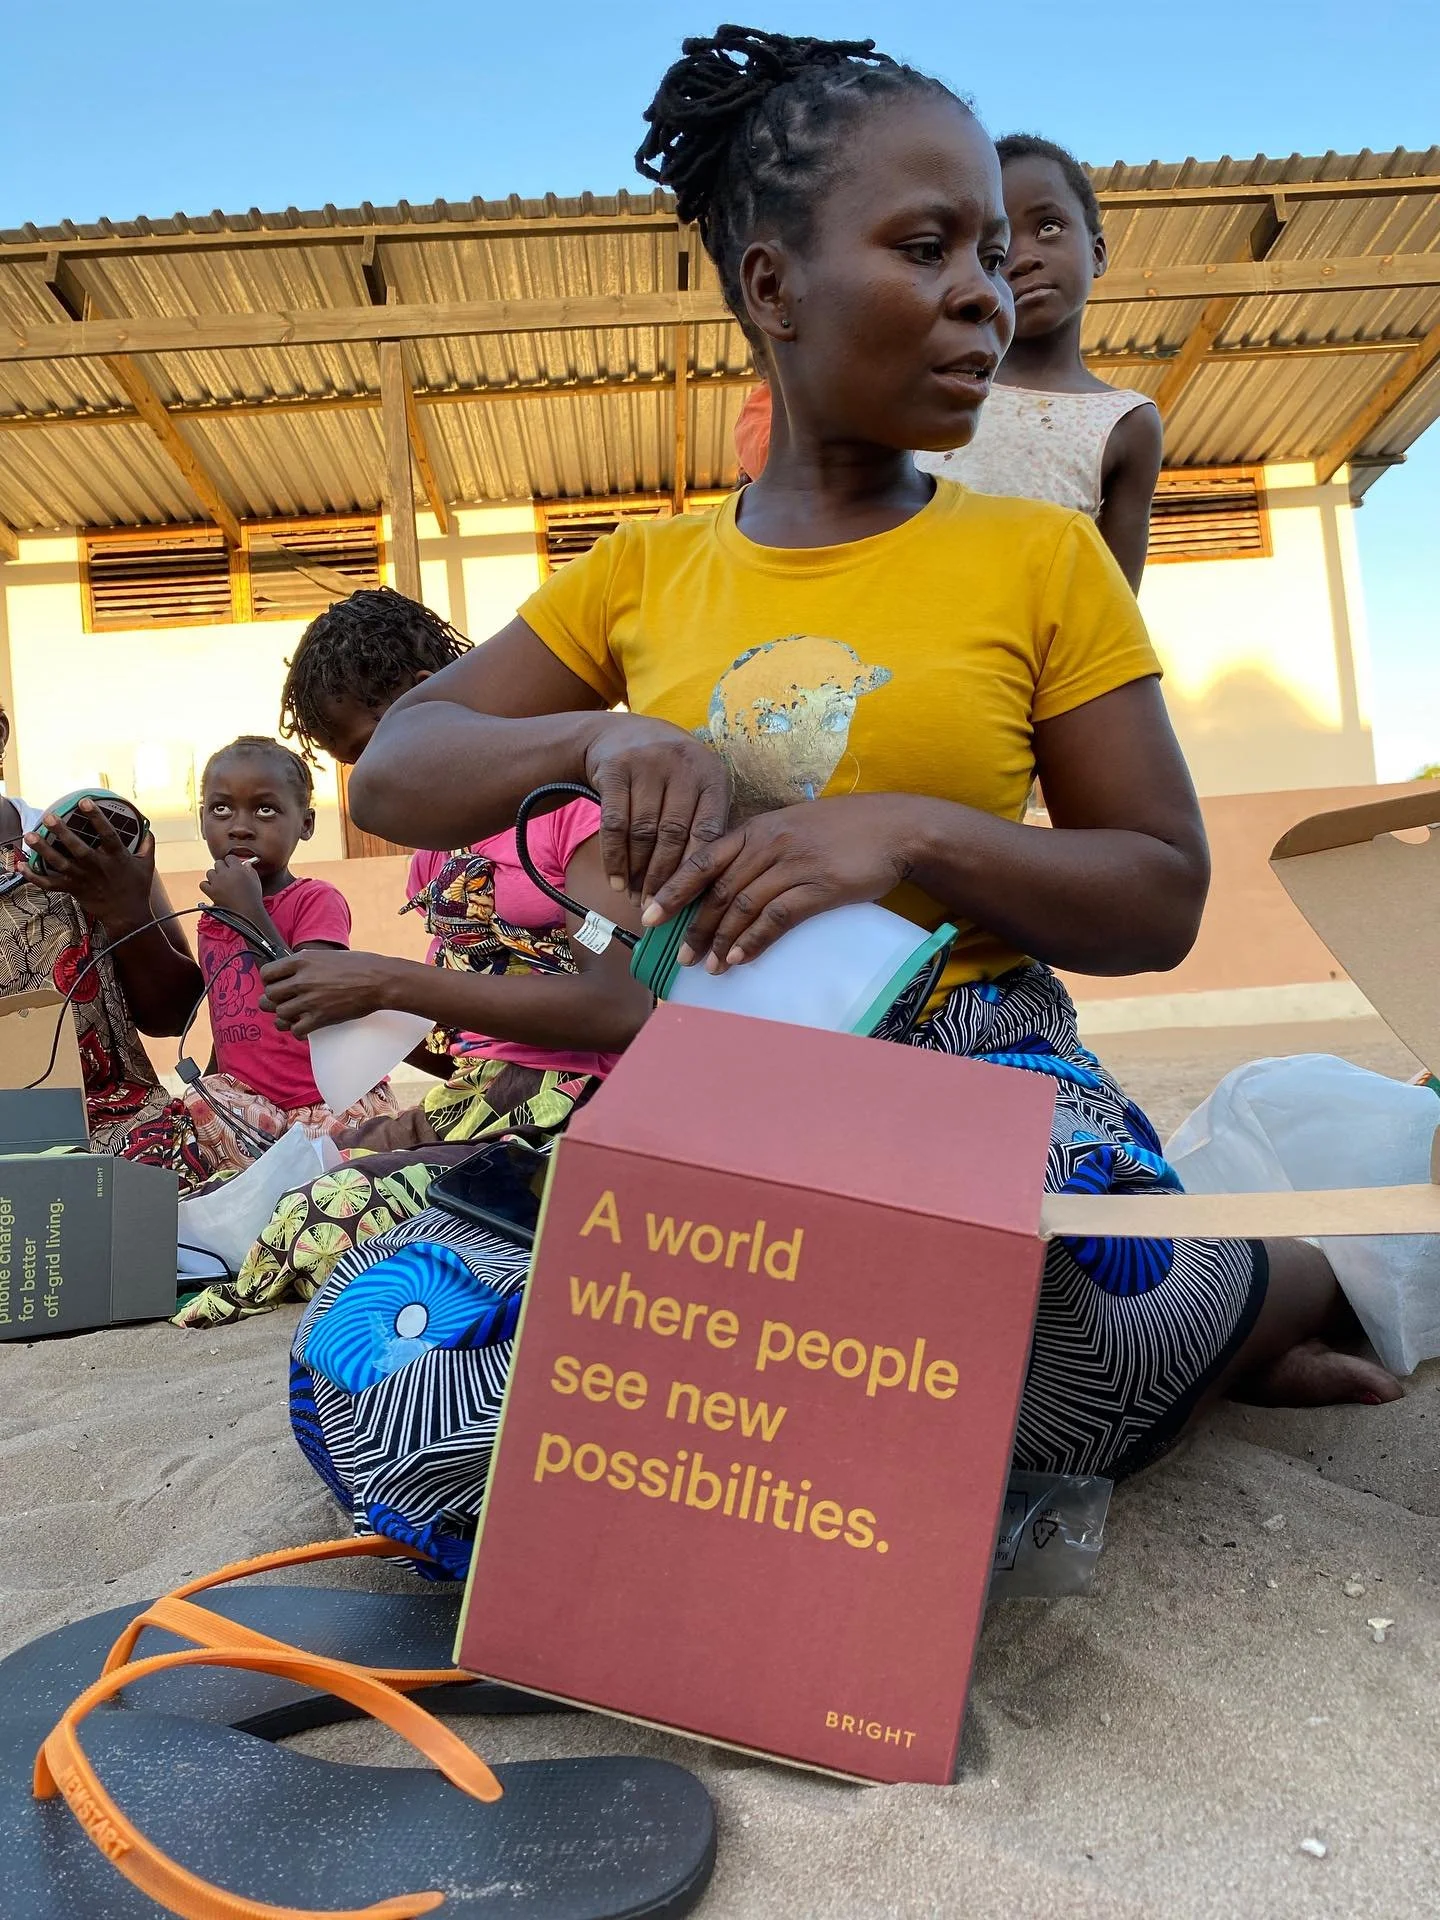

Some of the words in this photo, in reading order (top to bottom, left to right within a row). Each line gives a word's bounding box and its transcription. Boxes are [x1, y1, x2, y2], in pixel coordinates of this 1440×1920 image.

[45, 1198, 65, 1249] living.
[579, 1190, 622, 1244] A
[645, 1212, 804, 1282] world
[20, 1237, 36, 1292] better
[44, 1252, 63, 1318] off-grid
[18, 1296, 35, 1322] for
[569, 1271, 740, 1349] where
[755, 1319, 960, 1400] people
[550, 1354, 649, 1411] see
[665, 1380, 788, 1443] new
[533, 1432, 890, 1554] possibilities.
[825, 1710, 917, 1749] BR!GHT
